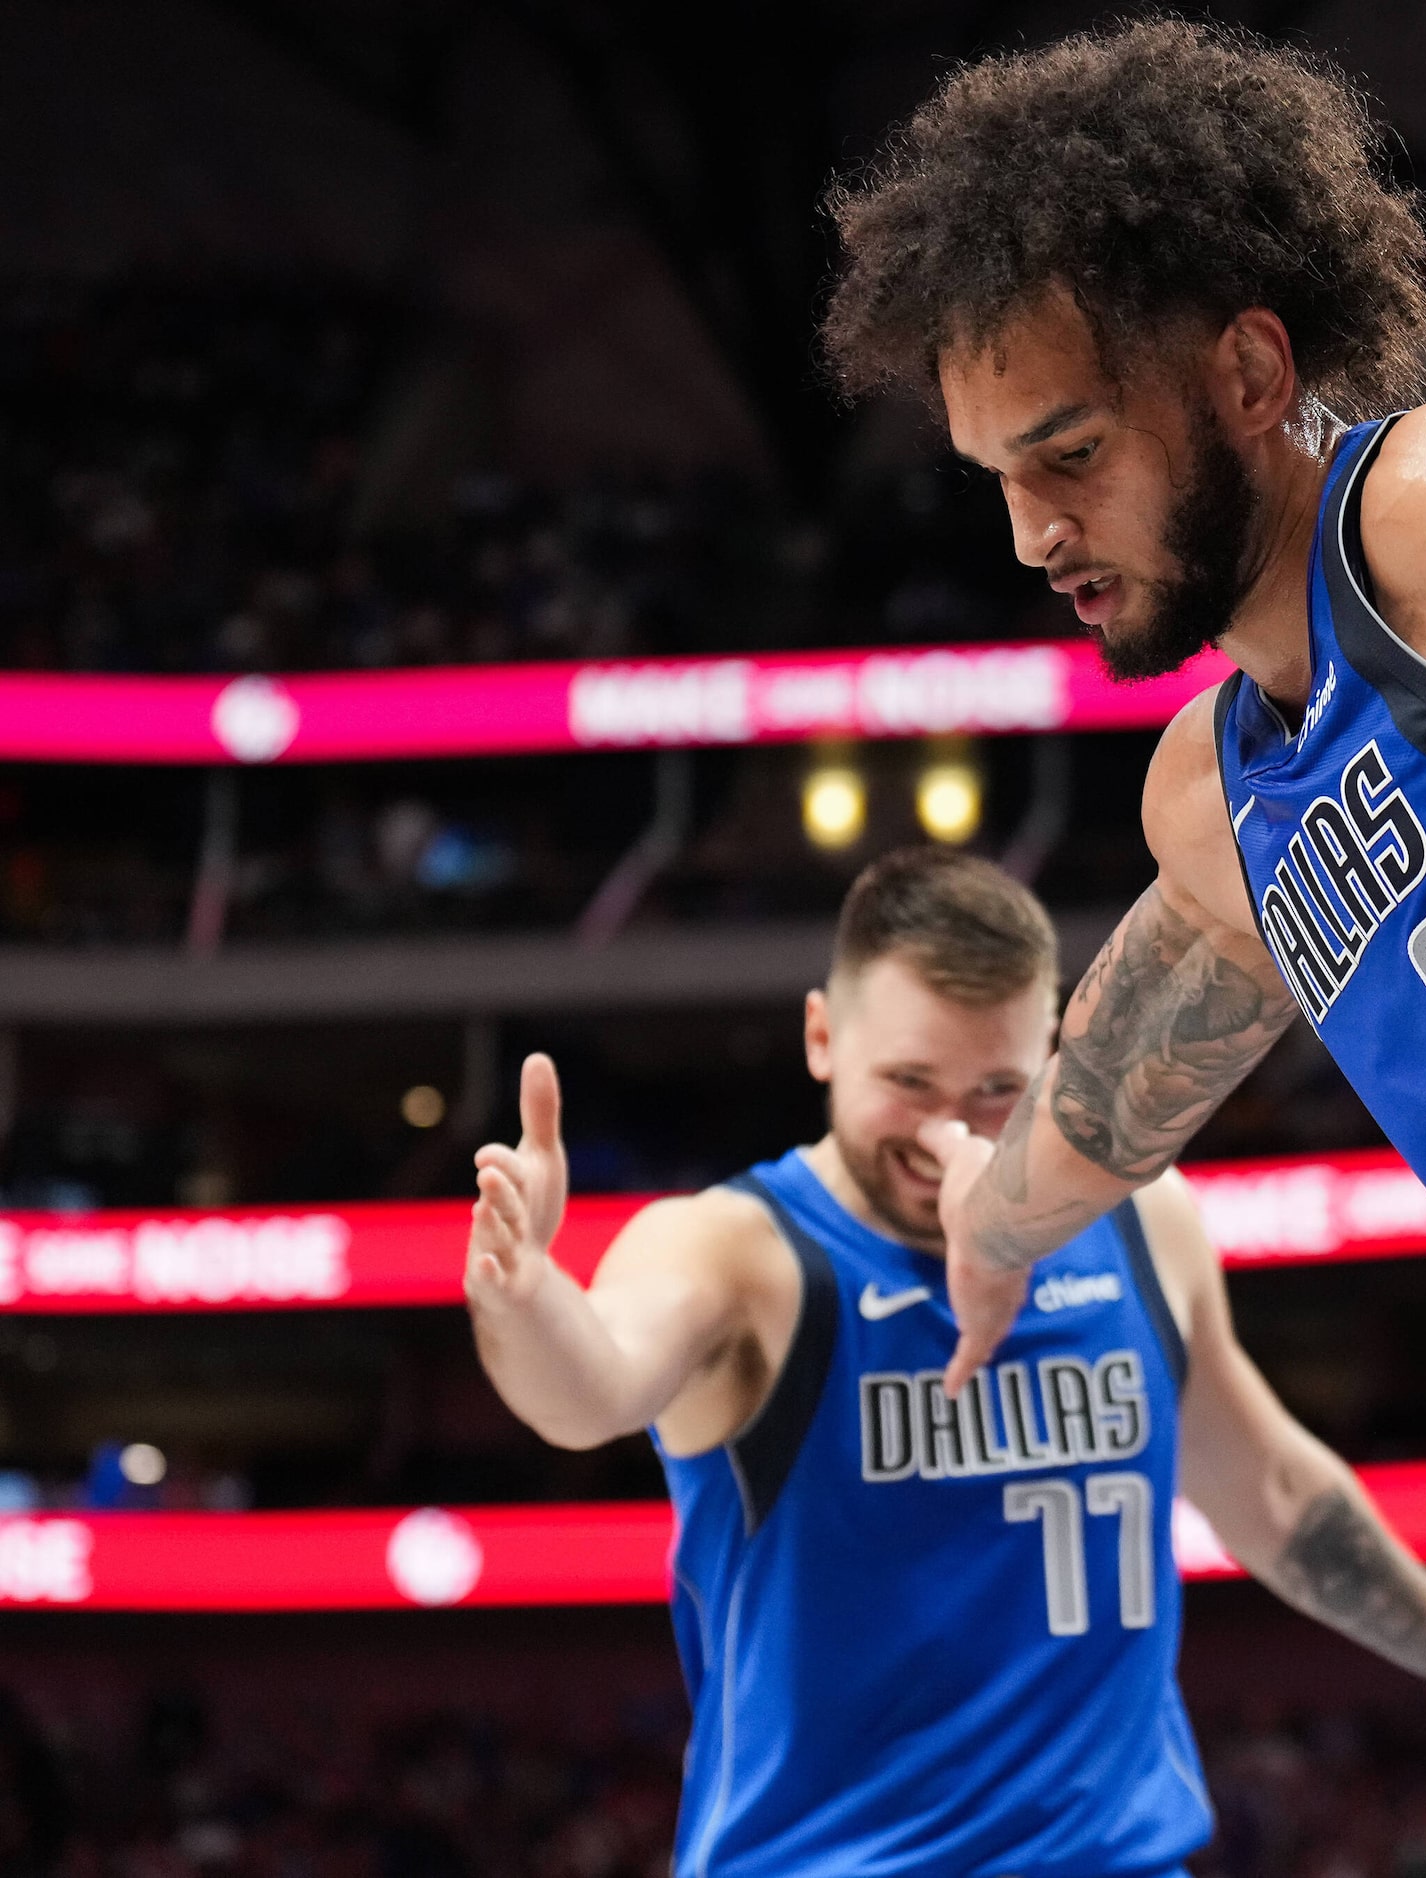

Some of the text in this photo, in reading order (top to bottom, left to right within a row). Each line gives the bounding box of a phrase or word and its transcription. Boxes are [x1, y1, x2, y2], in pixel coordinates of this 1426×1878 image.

[1297, 660, 1337, 753] chime
[1034, 1272, 1121, 1312] chime
[860, 1352, 1146, 1482] DALLAS
[1003, 1473, 1155, 1636] 77
